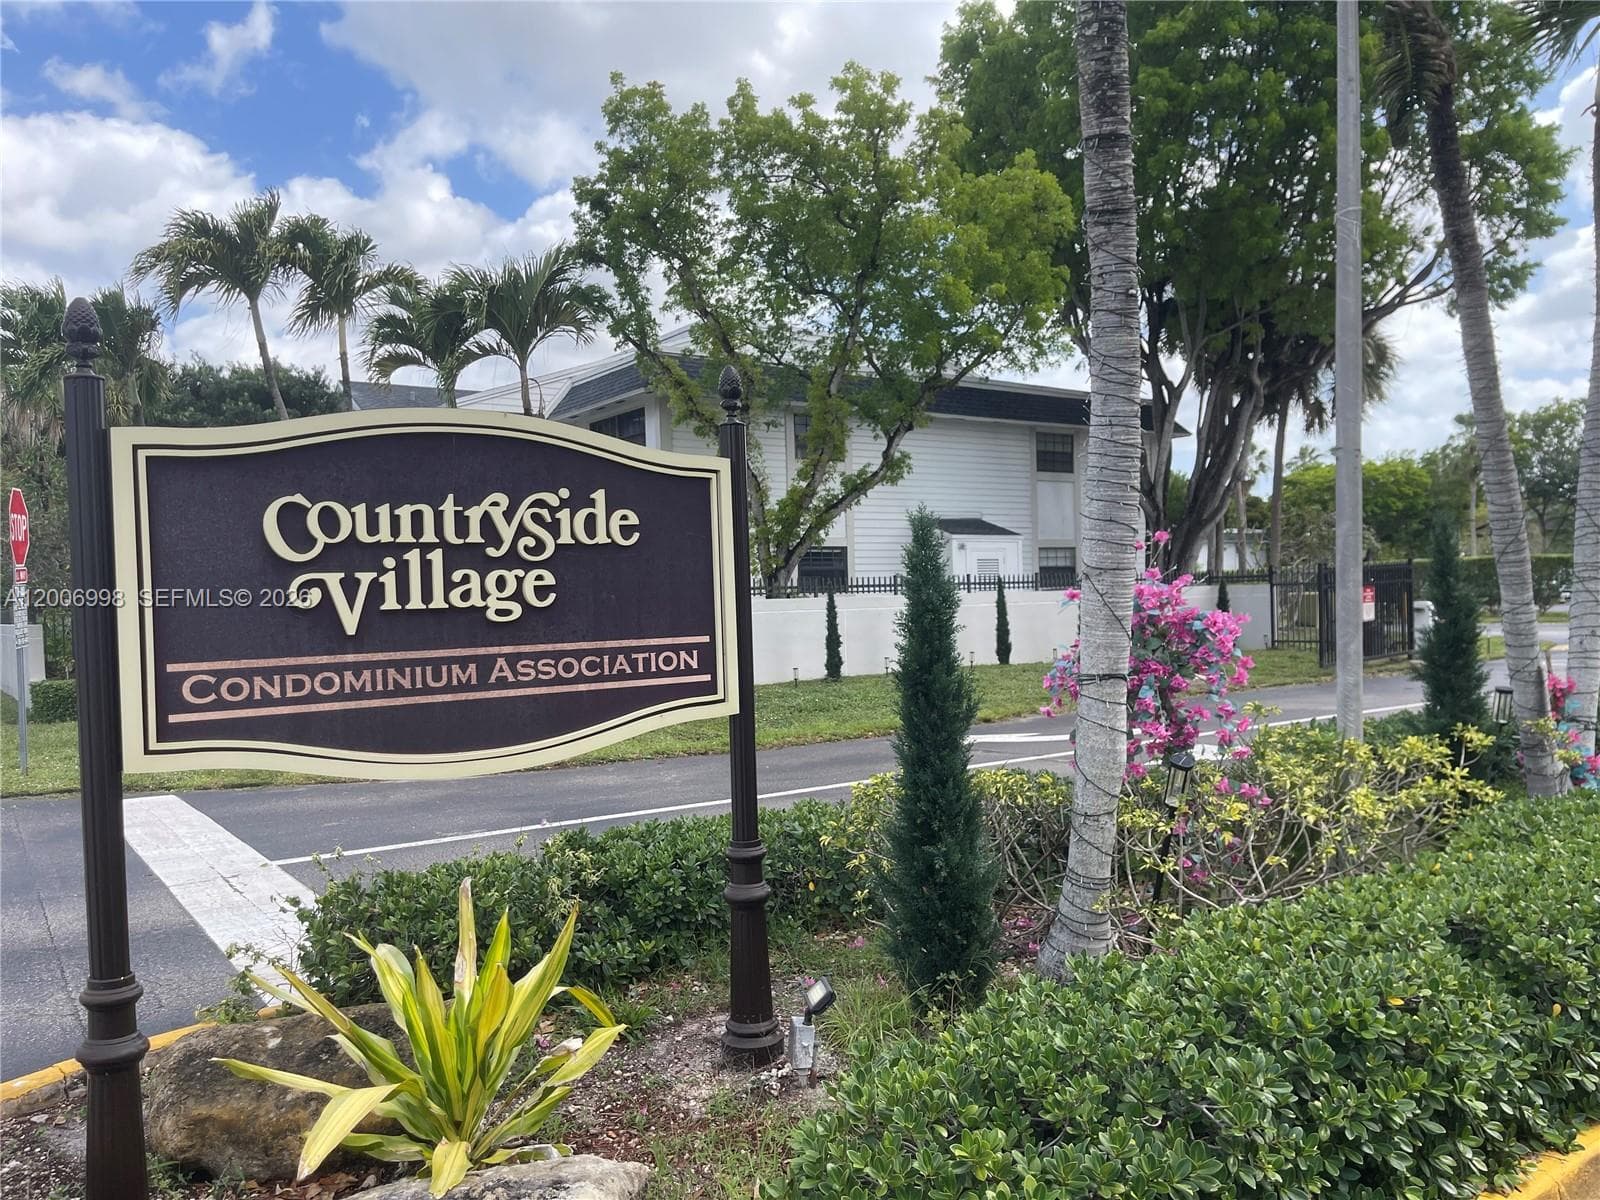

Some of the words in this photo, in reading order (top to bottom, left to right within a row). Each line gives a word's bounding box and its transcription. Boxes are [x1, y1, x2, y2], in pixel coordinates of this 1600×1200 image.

[11, 513, 27, 542] STOP
[288, 548, 557, 636] Village
[181, 662, 478, 705] CONDOMINIUM
[487, 649, 700, 684] ASSOCIATION
